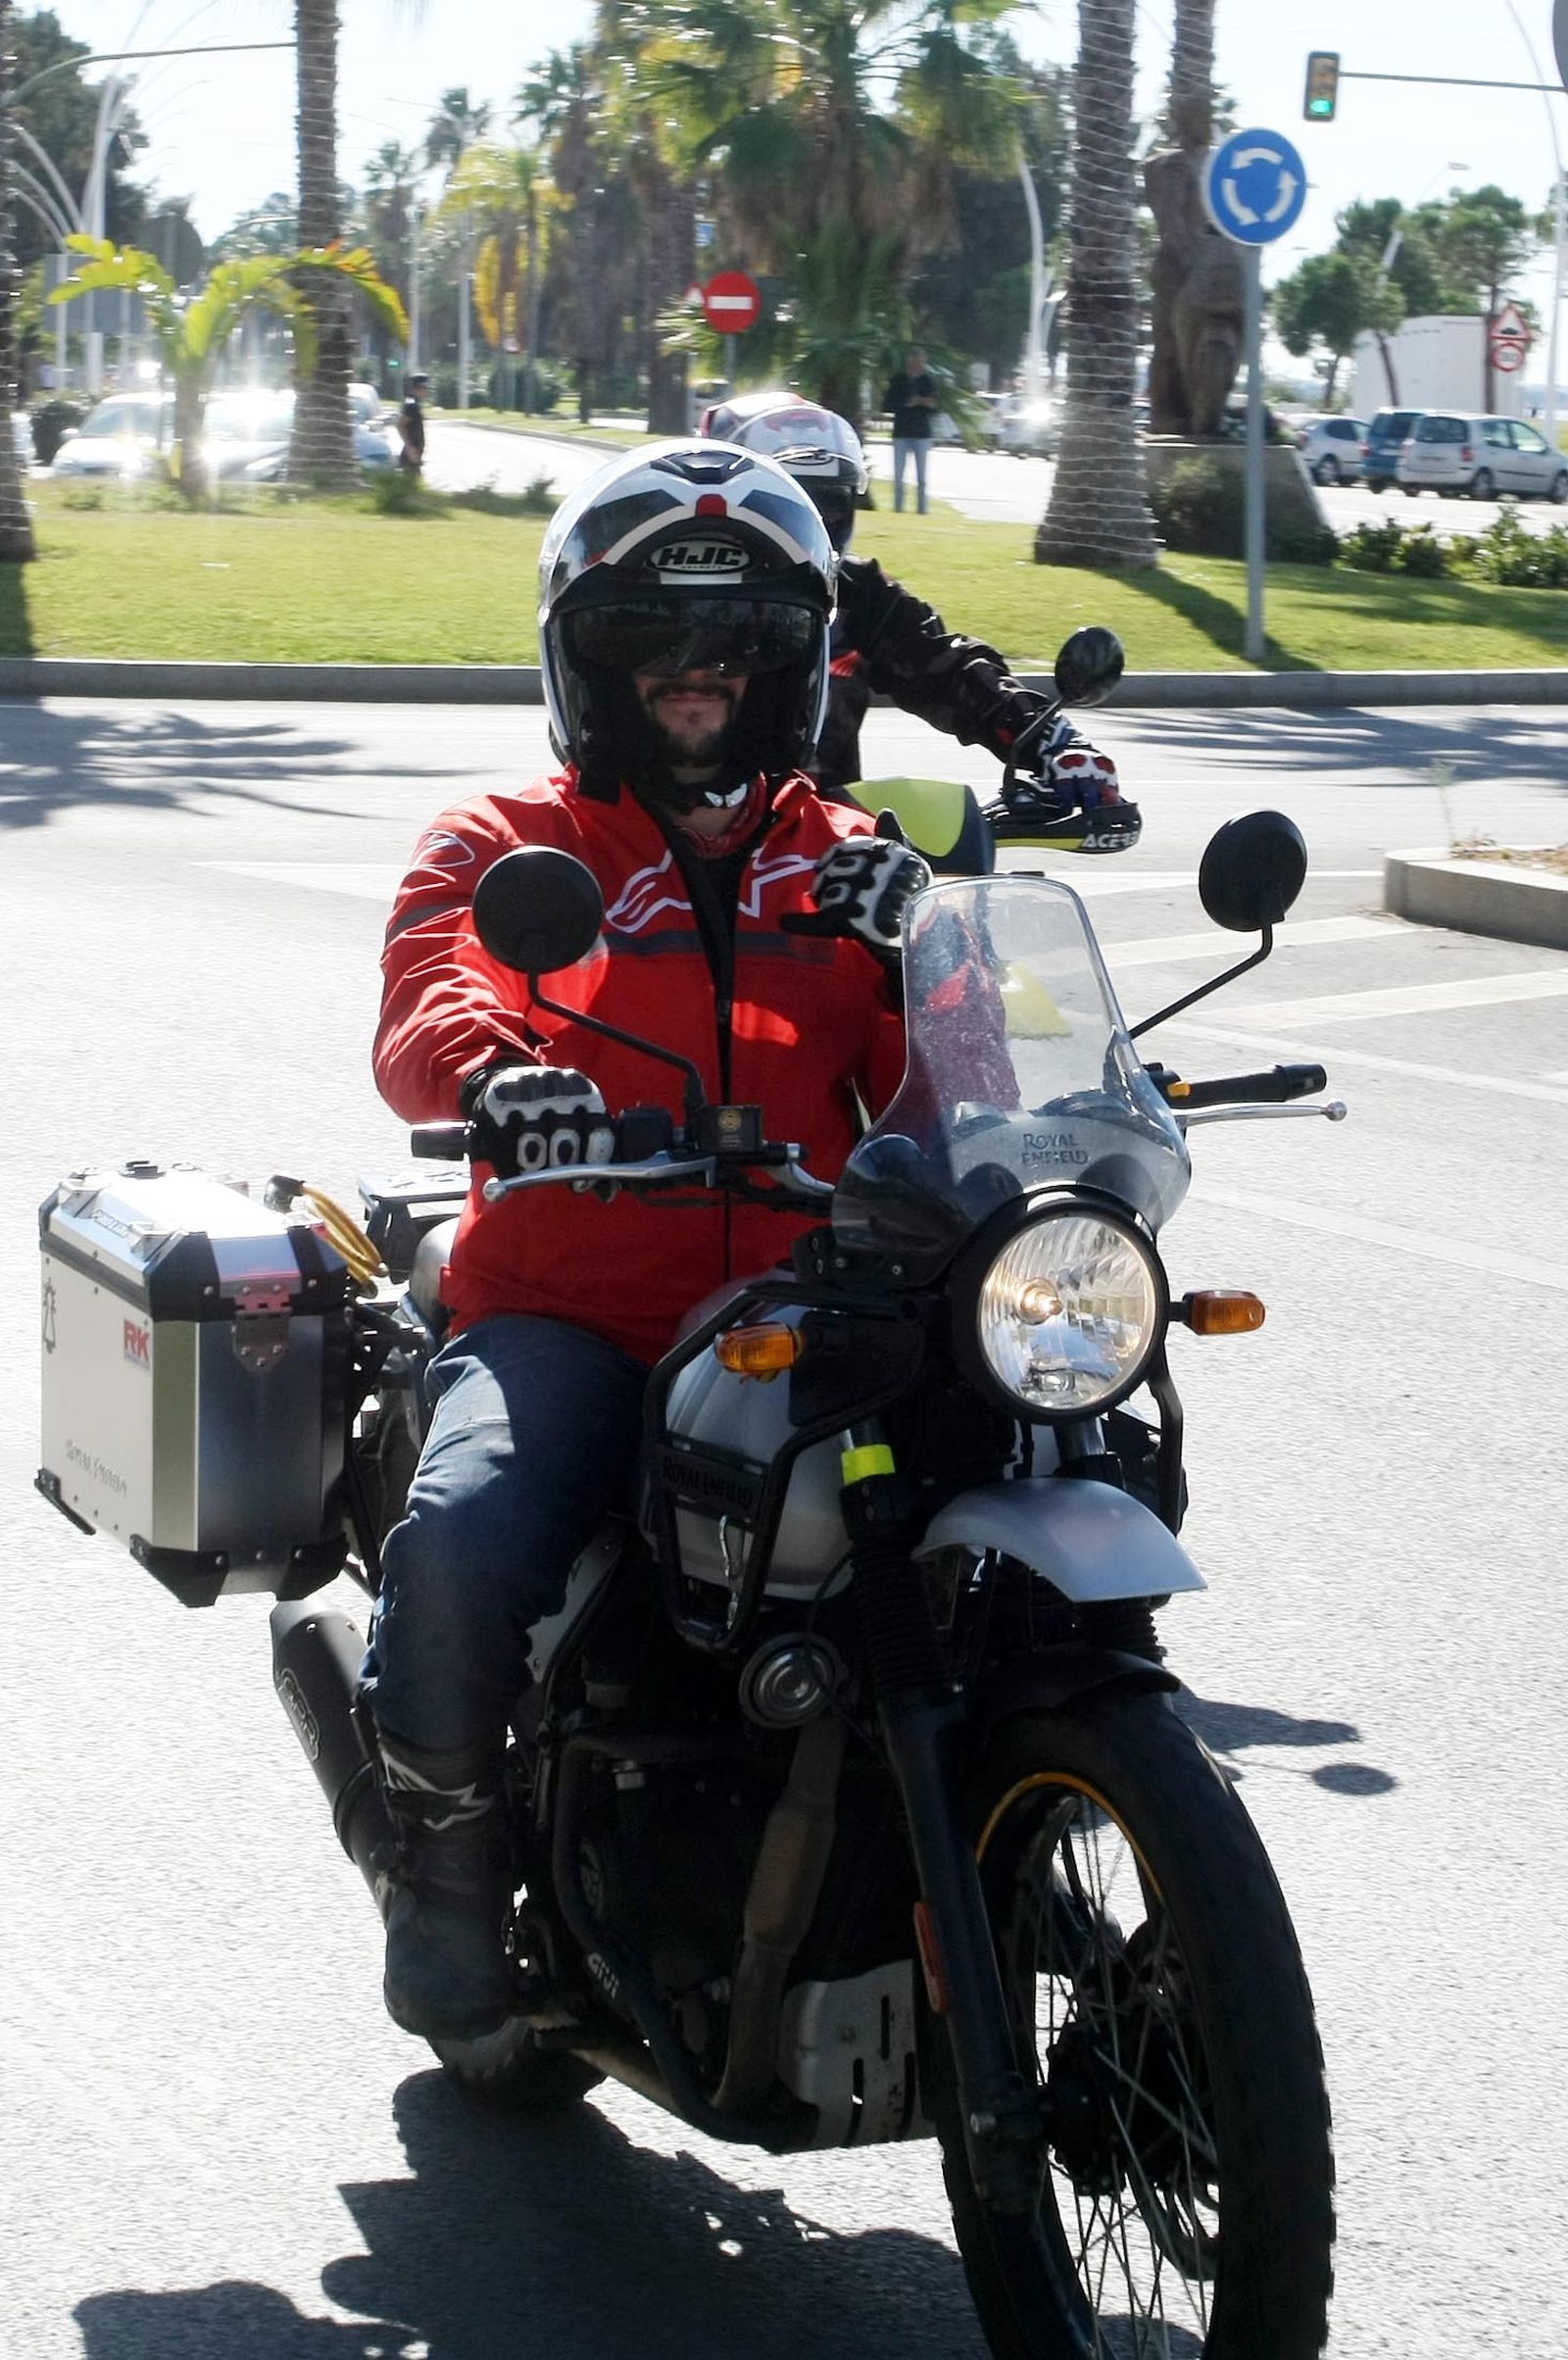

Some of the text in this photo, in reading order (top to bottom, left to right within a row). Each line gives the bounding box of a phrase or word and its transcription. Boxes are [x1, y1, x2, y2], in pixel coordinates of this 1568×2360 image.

[658, 547, 743, 565] HJC
[1022, 1133, 1079, 1150] ROYAL
[1021, 1150, 1088, 1165] ENFIELD
[123, 1318, 150, 1362] RK
